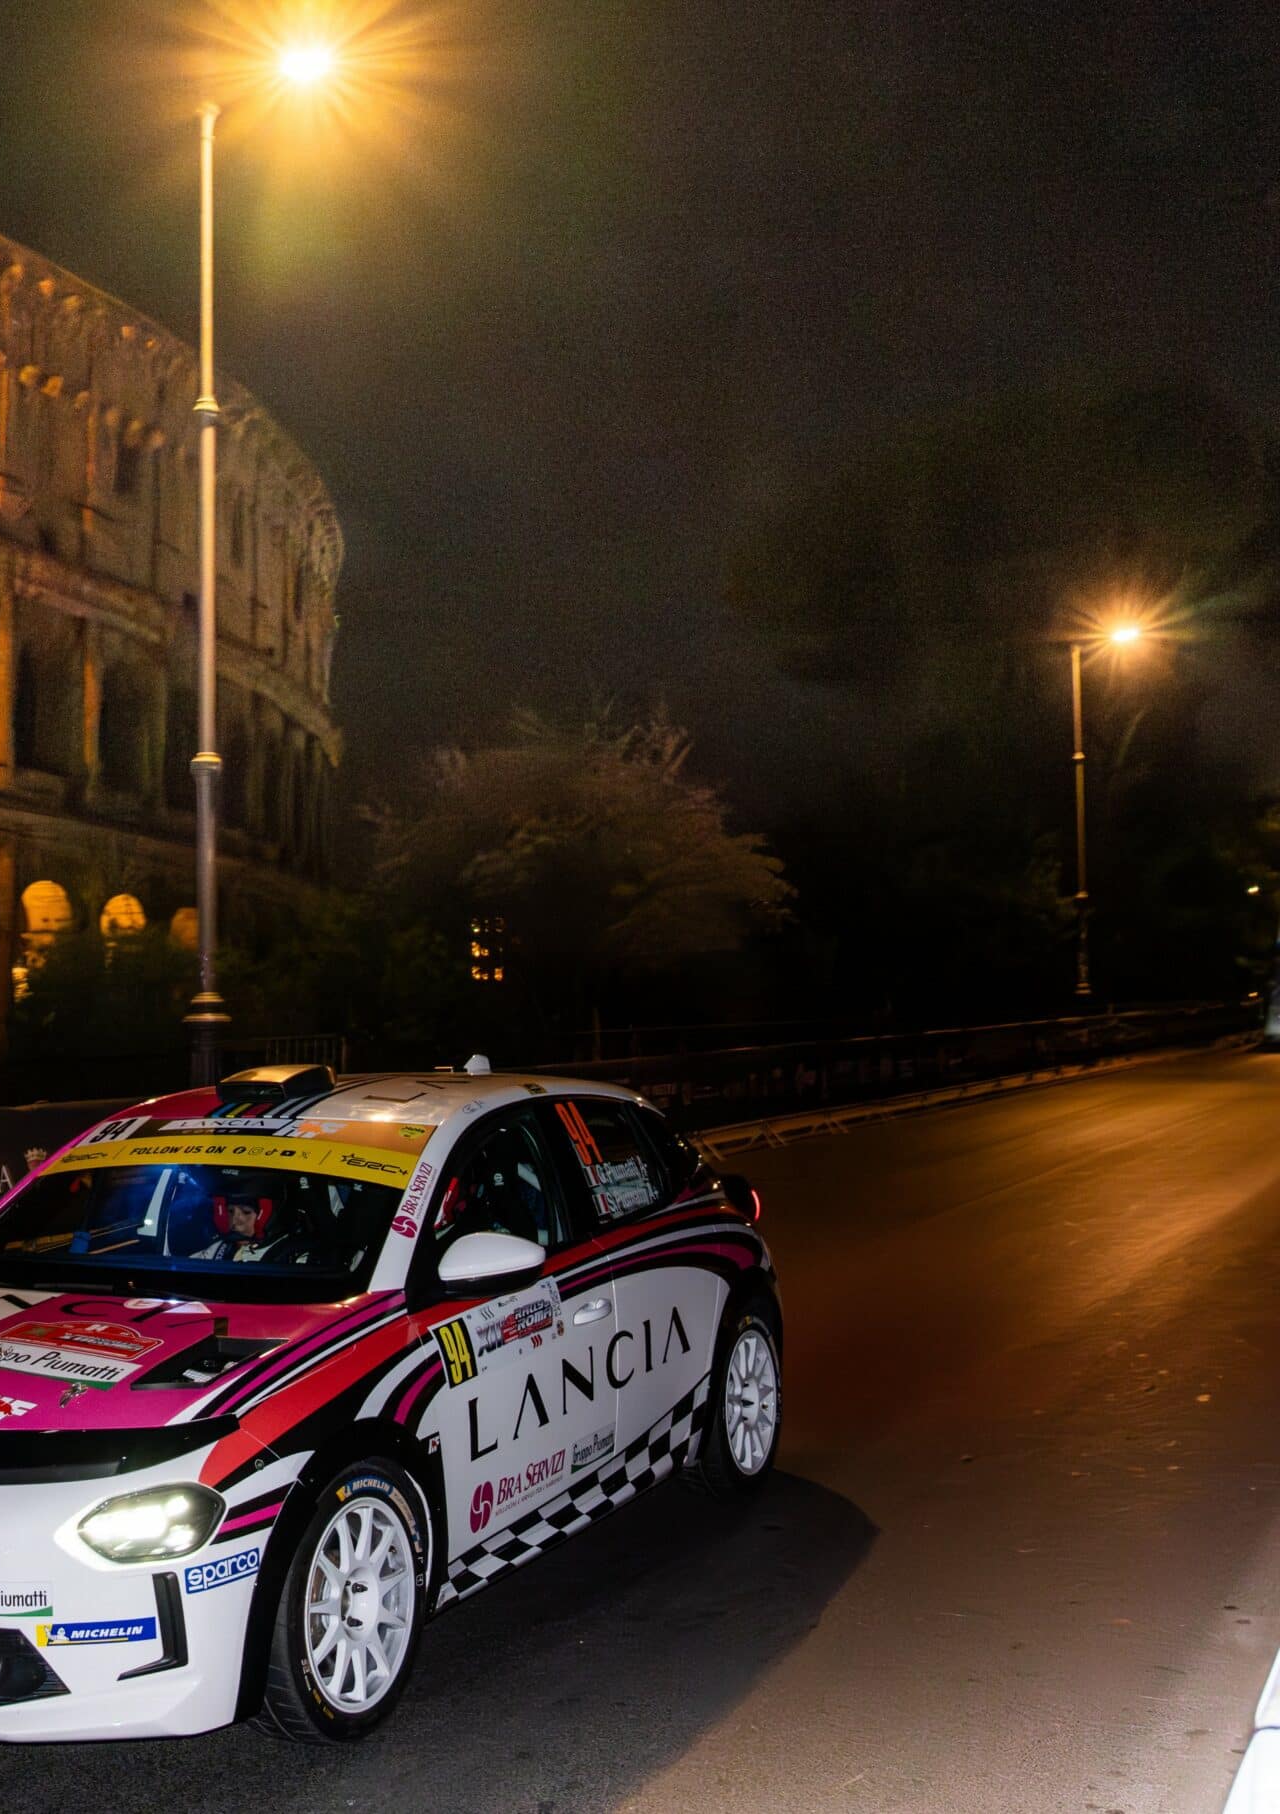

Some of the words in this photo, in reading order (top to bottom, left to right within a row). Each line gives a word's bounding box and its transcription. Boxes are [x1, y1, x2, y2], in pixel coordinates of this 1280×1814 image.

[90, 1119, 138, 1143] 94
[179, 1118, 265, 1127] LANCIA
[129, 1146, 180, 1156] FOLLOW
[184, 1146, 203, 1154] US
[205, 1146, 227, 1154] ON
[409, 1162, 433, 1196] SERVIZI
[401, 1195, 420, 1216] BRA
[439, 1320, 474, 1384] 94
[32, 1351, 124, 1381] Piumatti
[469, 1306, 691, 1462] LANCIA
[352, 1479, 391, 1492] MICHELIN
[497, 1473, 522, 1505] BRA
[524, 1448, 566, 1491] SERVIZI
[190, 1550, 258, 1590] sparco
[70, 1624, 144, 1641] MICHELIN
